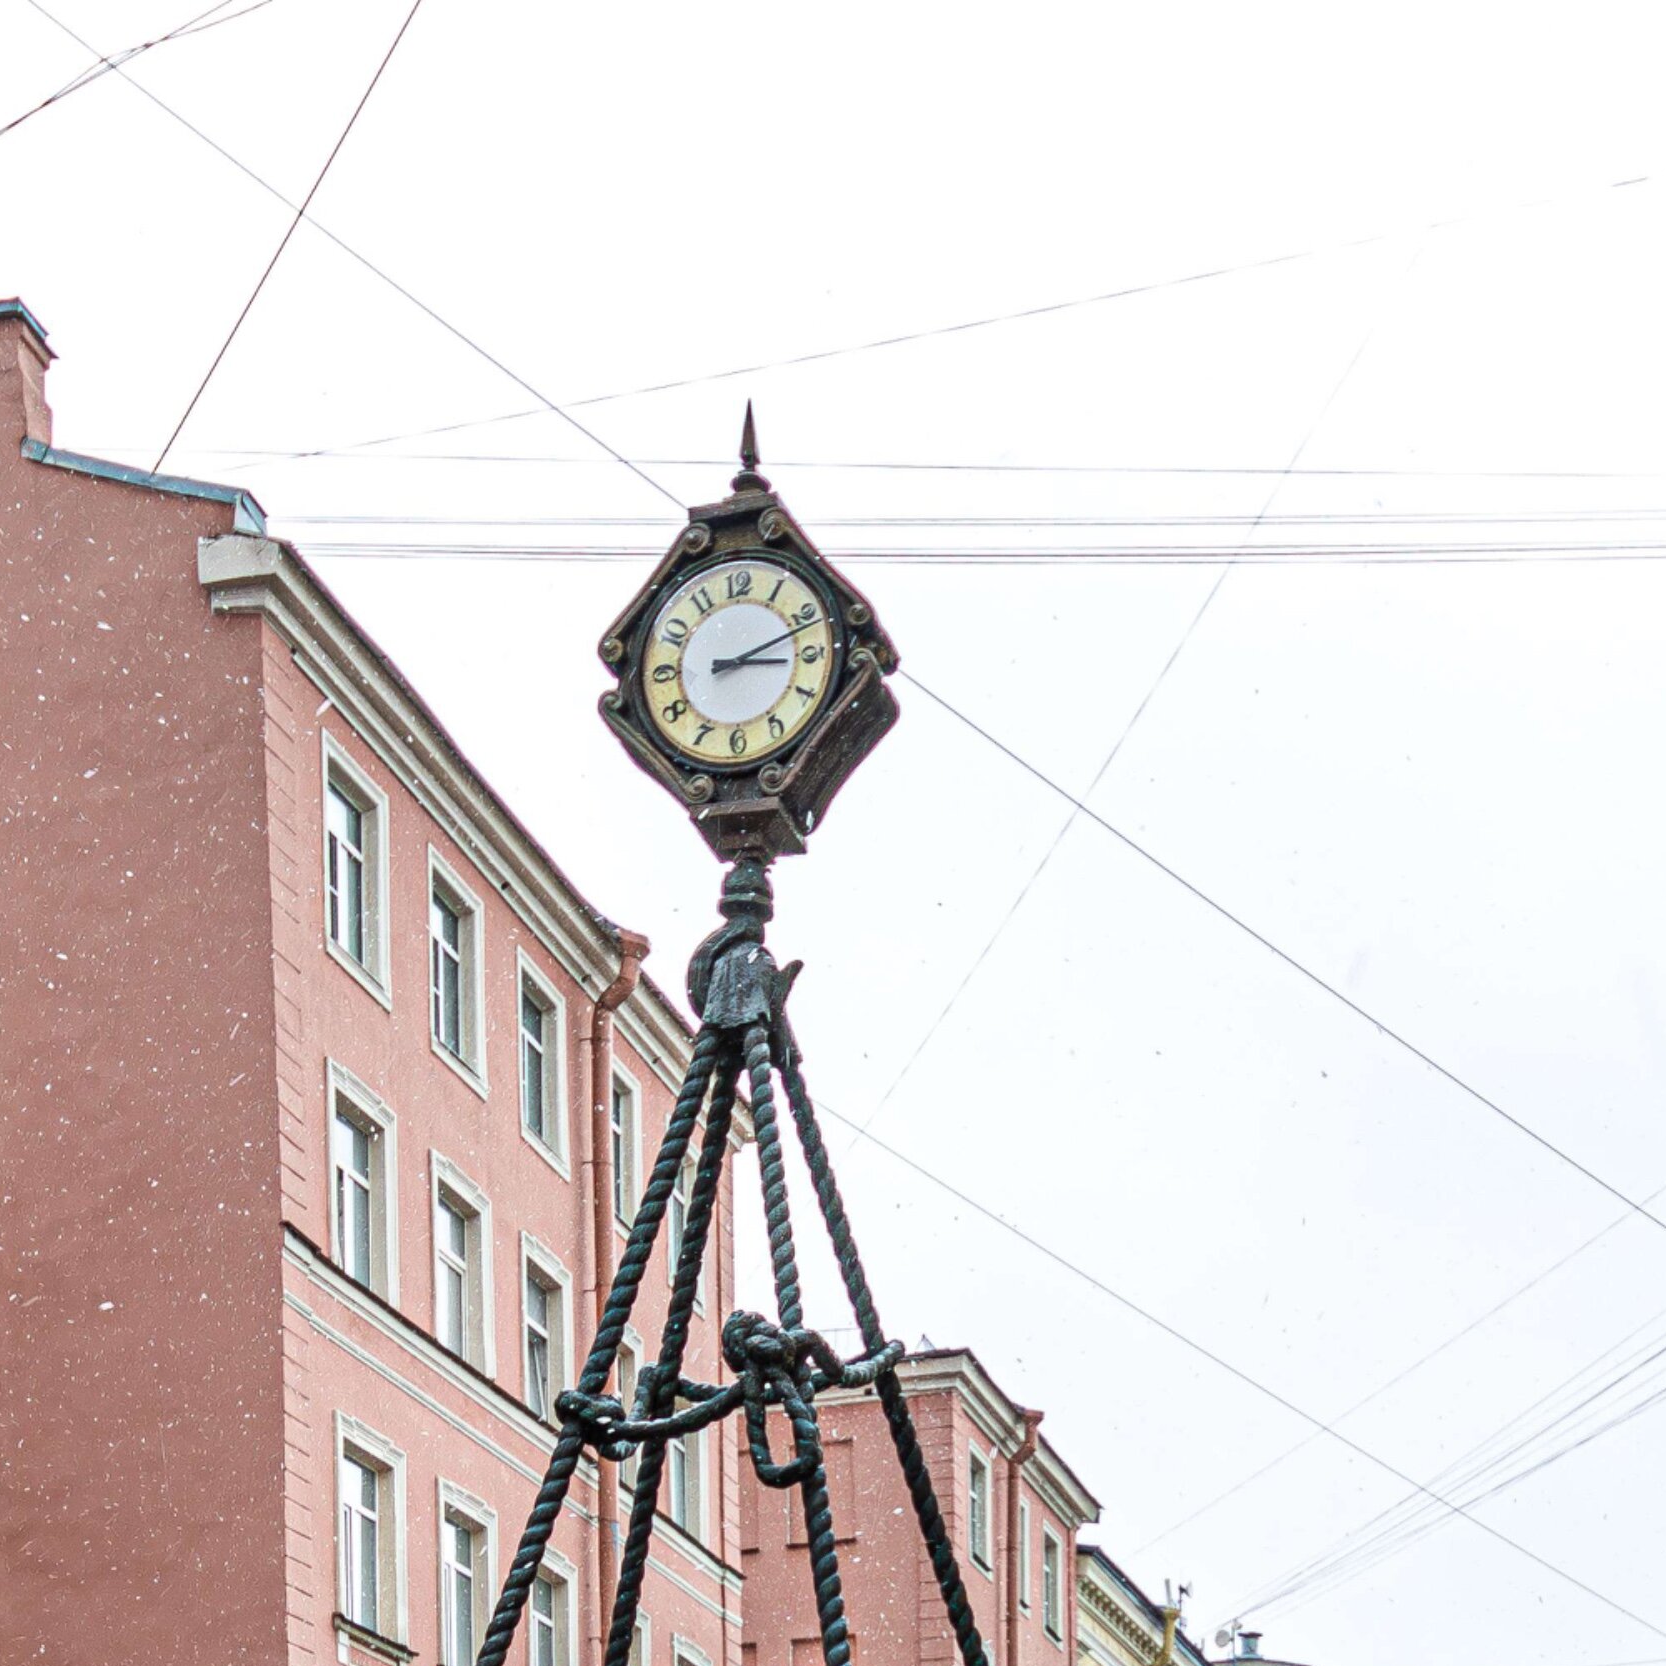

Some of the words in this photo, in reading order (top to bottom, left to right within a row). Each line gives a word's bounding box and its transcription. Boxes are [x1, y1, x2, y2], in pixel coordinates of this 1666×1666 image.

[726, 571, 752, 599] 12
[769, 579, 784, 602] 1
[690, 586, 715, 615] 11
[791, 603, 816, 625] 2
[661, 618, 688, 648] 10
[801, 645, 825, 664] 3
[653, 664, 676, 683] 9
[796, 685, 815, 706] 4
[662, 700, 686, 723] 8
[693, 724, 715, 746] 7
[768, 715, 784, 739] 5
[729, 729, 747, 755] 6
